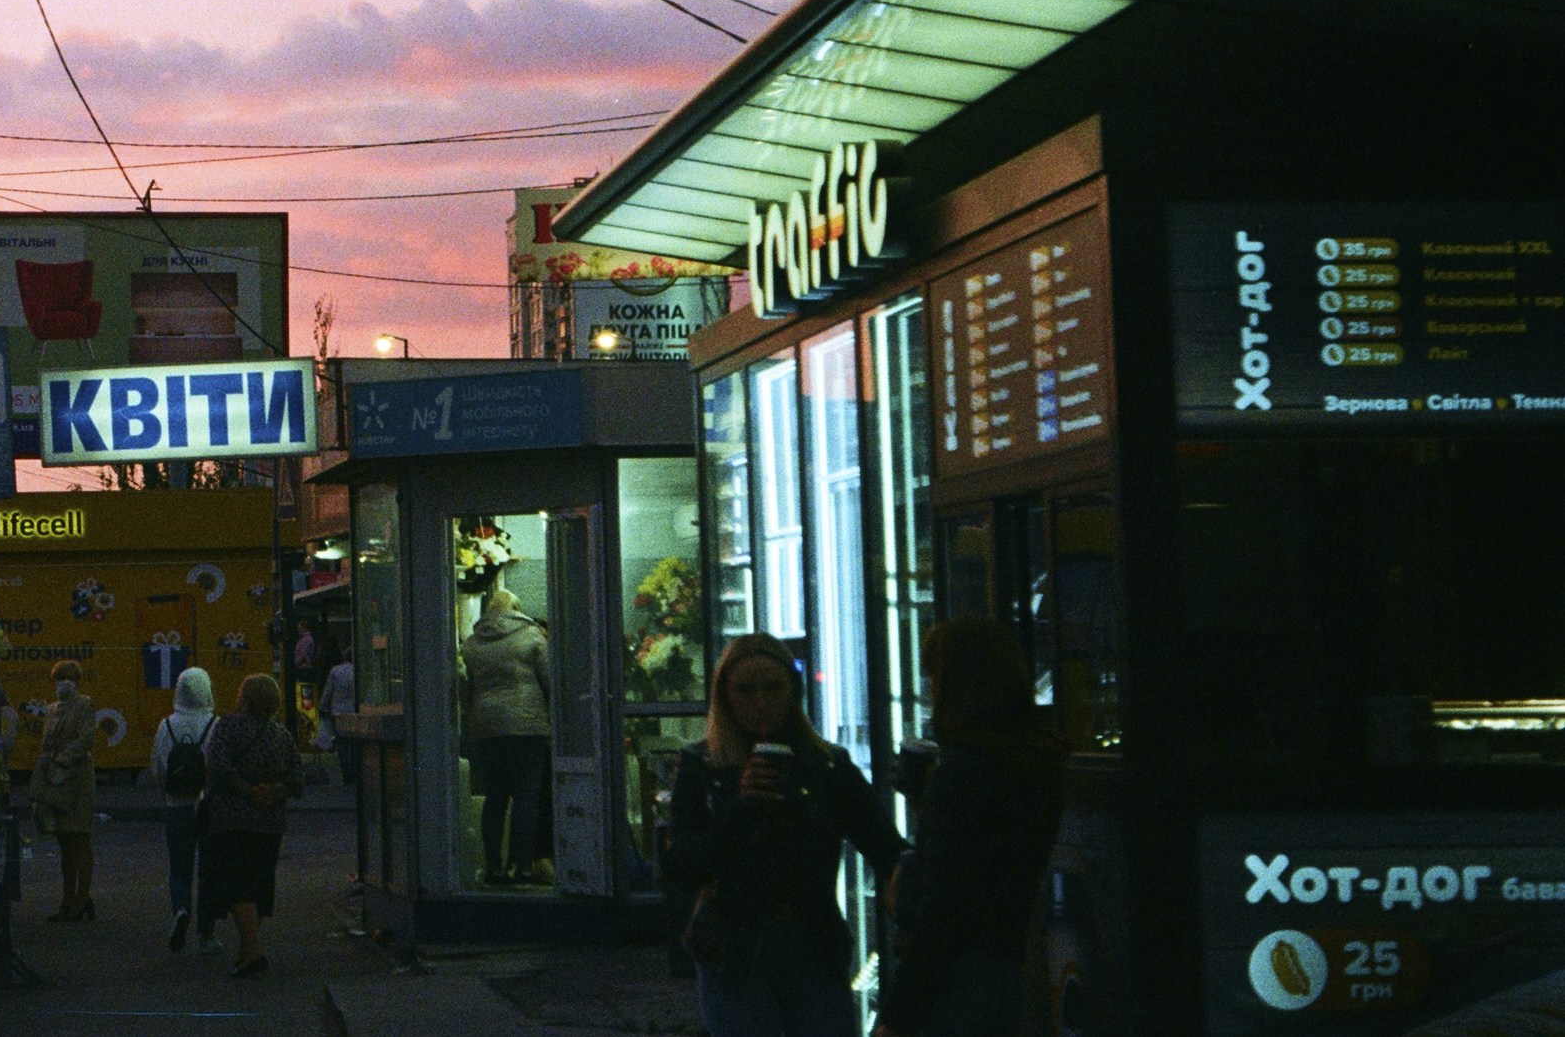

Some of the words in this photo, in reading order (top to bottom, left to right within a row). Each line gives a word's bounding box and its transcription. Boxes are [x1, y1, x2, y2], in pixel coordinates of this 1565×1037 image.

[608, 304, 685, 320] КОЖНА
[1233, 229, 1274, 411] Хот-дог
[656, 323, 702, 339] ПІЦ
[1347, 321, 1370, 335] 25
[1349, 347, 1371, 362] 25
[49, 369, 306, 453] КВІТИ
[1323, 394, 1409, 415] Зернова
[1426, 392, 1493, 411] Світла
[1244, 853, 1492, 911] Хот-дог
[1342, 940, 1402, 977] 25
[1350, 982, 1395, 1002] грн
